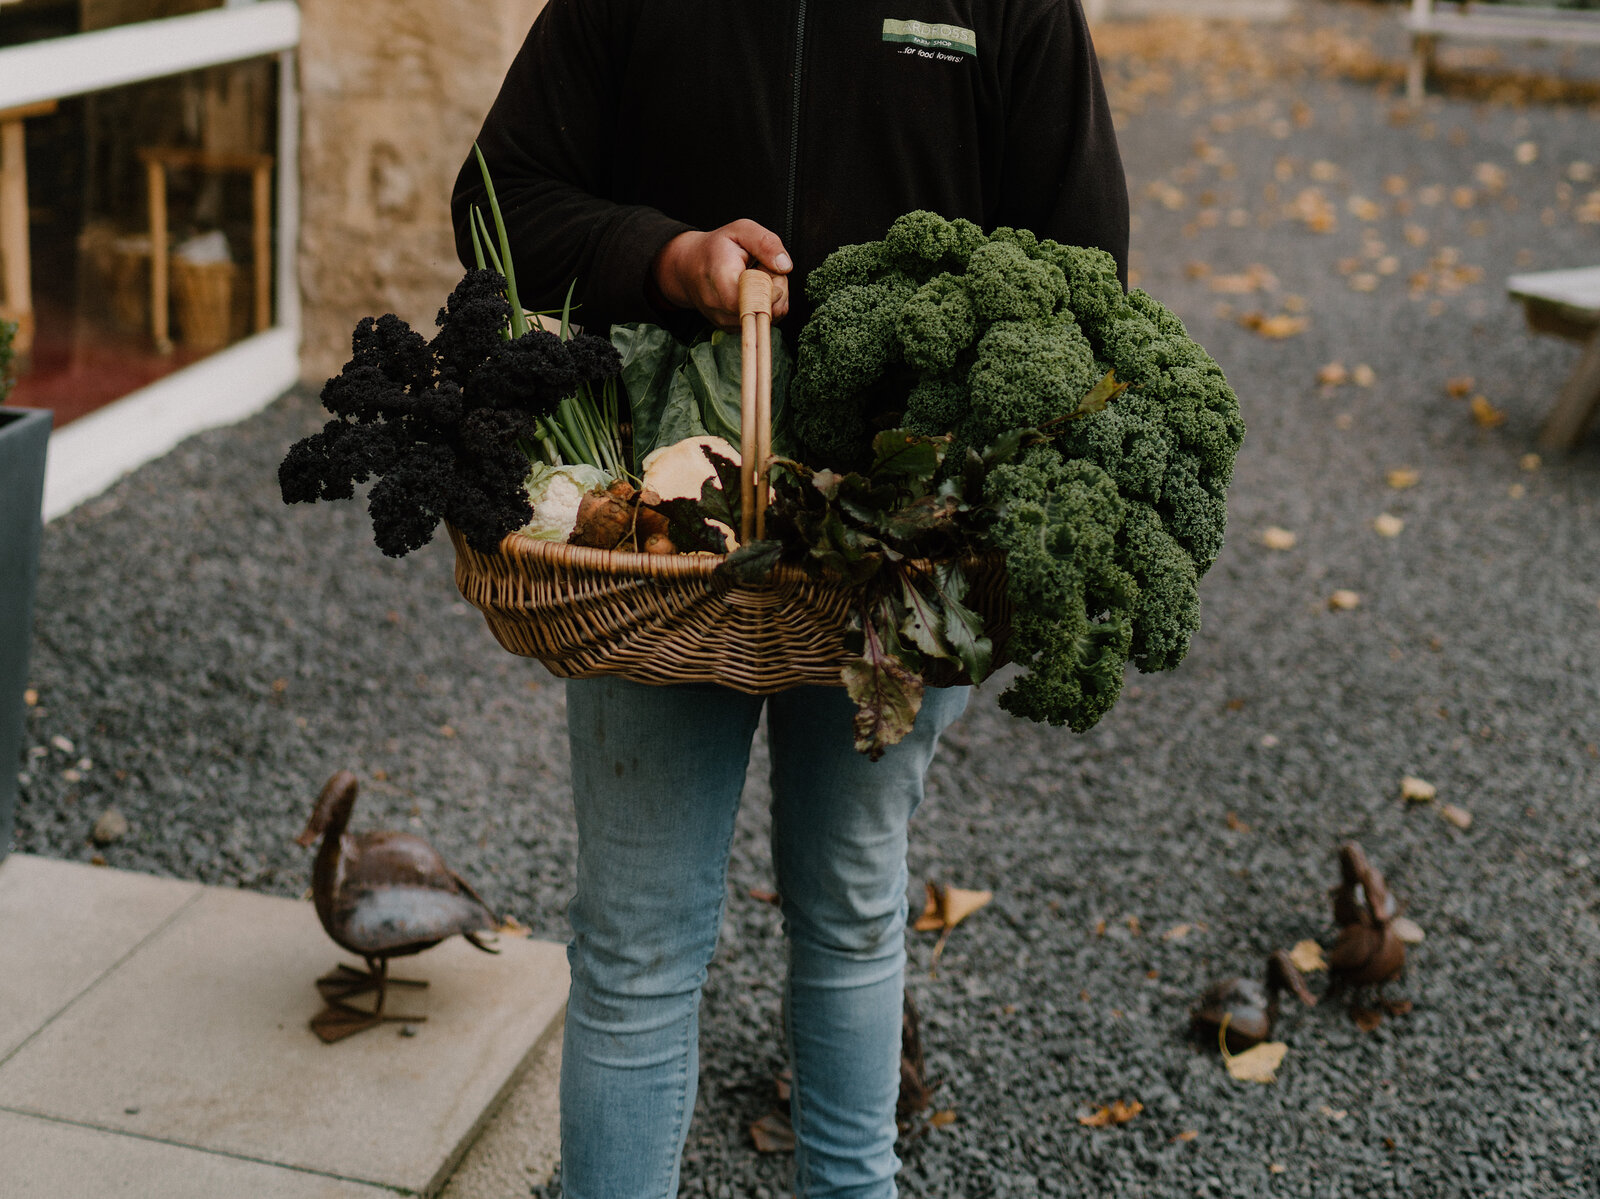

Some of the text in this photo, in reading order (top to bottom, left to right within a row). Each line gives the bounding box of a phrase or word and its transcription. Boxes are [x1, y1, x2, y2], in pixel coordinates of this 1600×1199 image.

[903, 22, 969, 41] ARDROSS
[917, 49, 935, 59] food
[936, 52, 964, 63] lovers!
